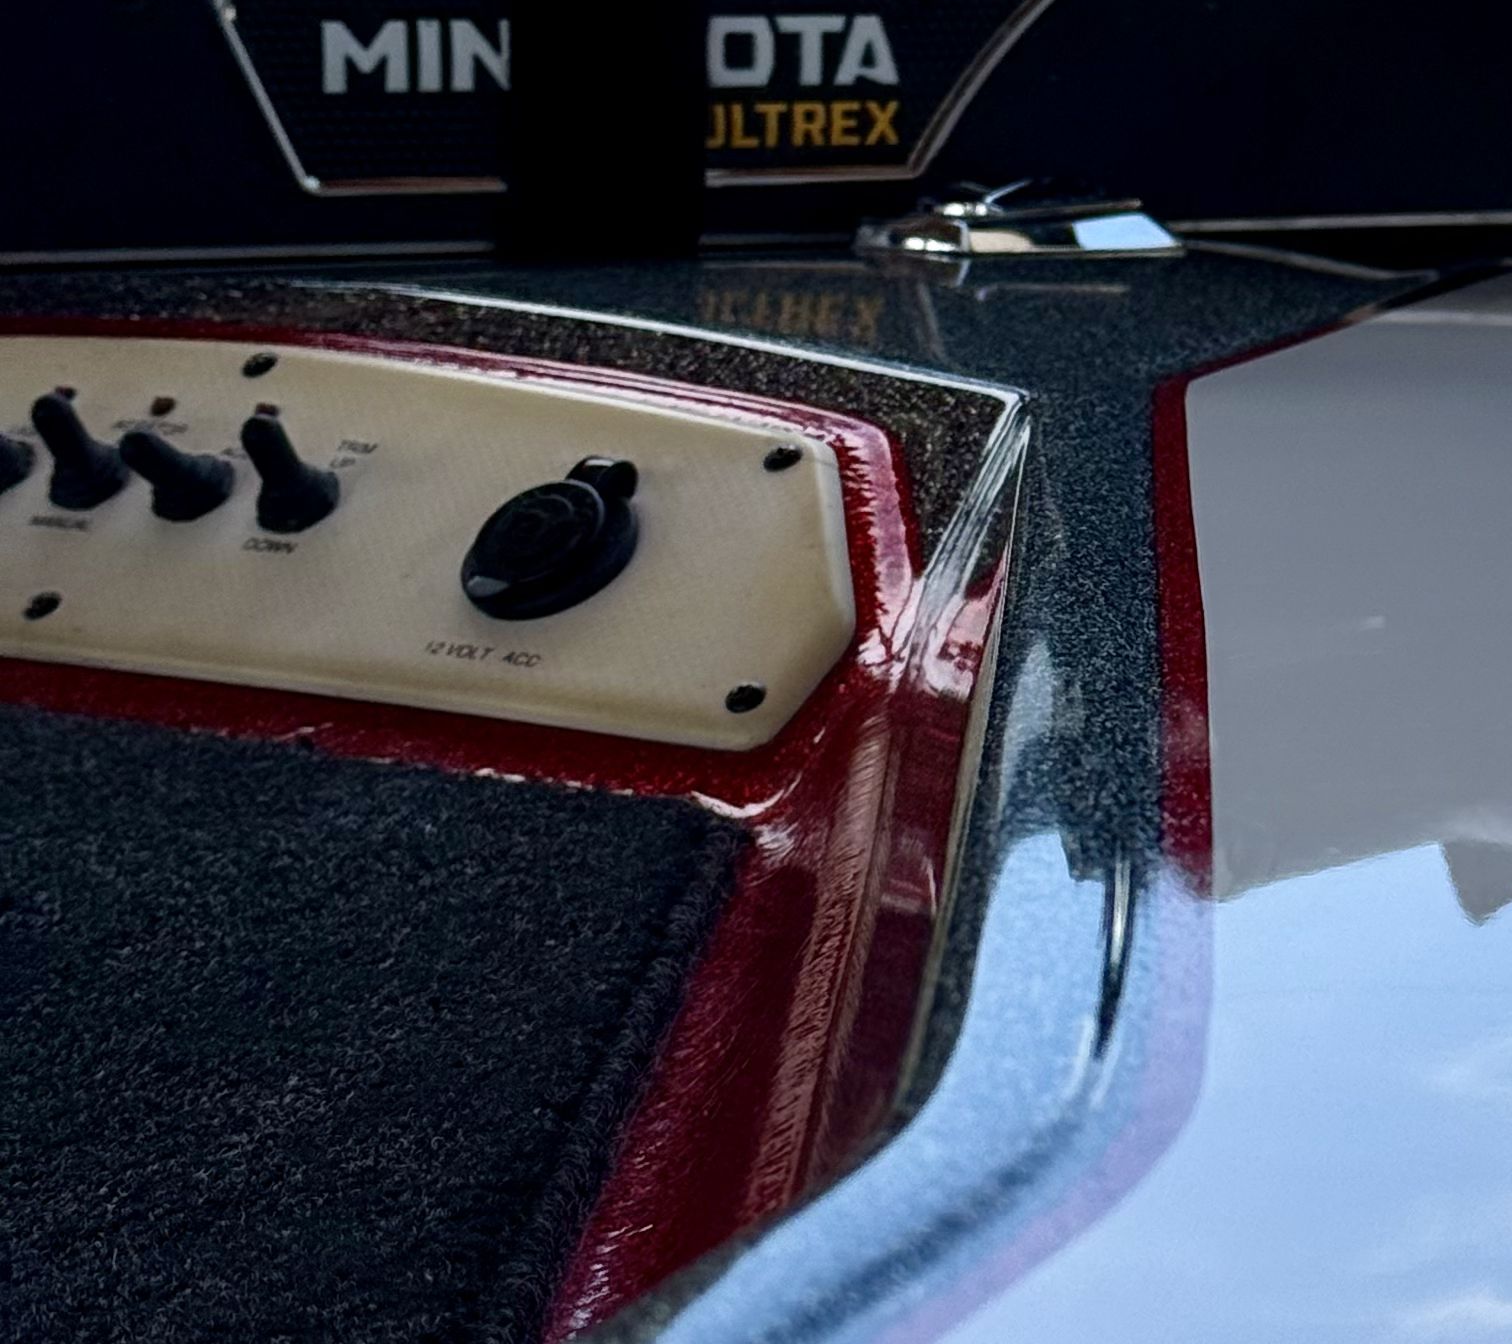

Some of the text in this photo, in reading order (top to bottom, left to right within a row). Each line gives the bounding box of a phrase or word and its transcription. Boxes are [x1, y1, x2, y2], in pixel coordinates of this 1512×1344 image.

[320, 13, 900, 94] MIN OTA
[447, 642, 496, 661] VOLT
[502, 650, 542, 668] ACC
